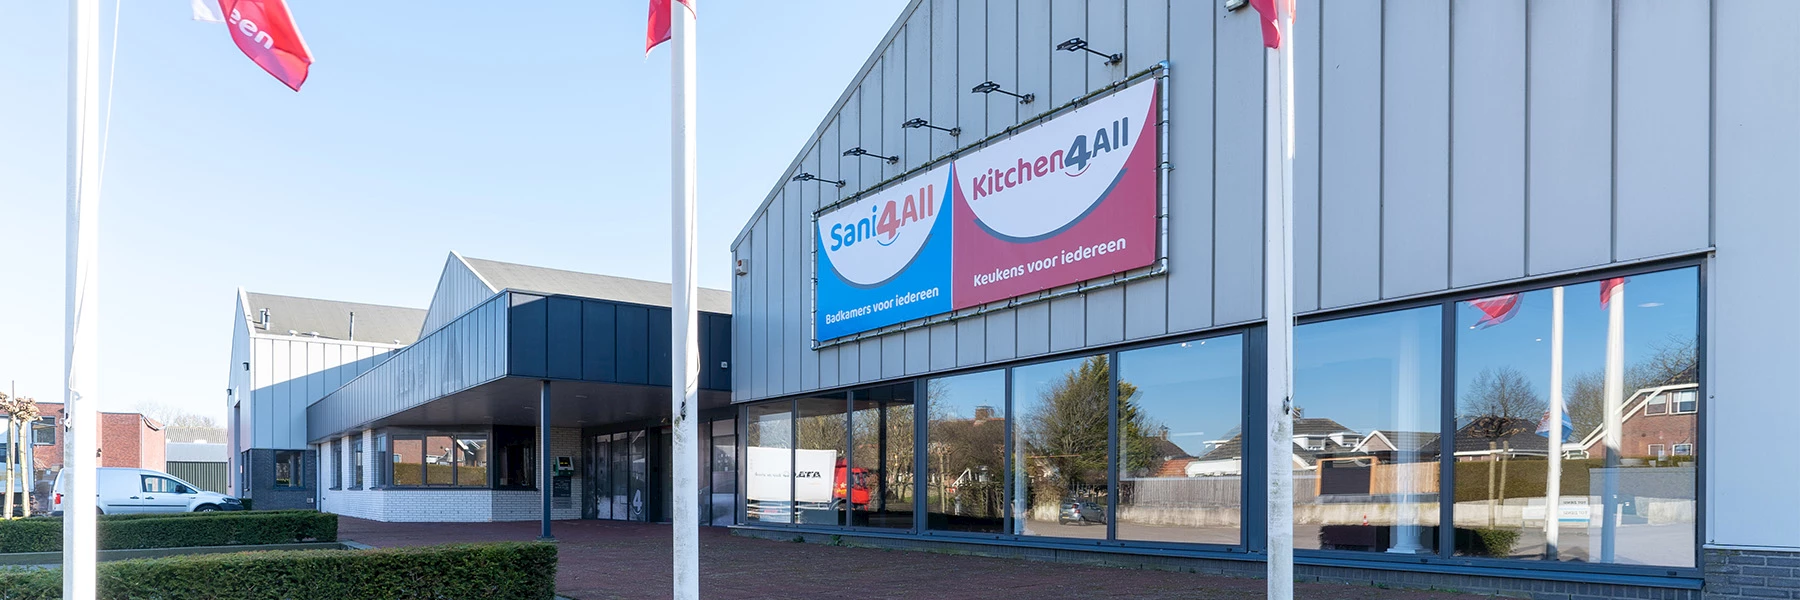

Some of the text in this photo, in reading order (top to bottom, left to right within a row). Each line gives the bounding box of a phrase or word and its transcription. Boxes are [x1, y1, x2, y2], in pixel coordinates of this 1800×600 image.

[972, 116, 1129, 201] Kitchen4All
[830, 184, 934, 252] Sani4All
[973, 237, 1127, 287] Keukens voor iedereen
[825, 286, 939, 325] Badkamers voor iedereen
